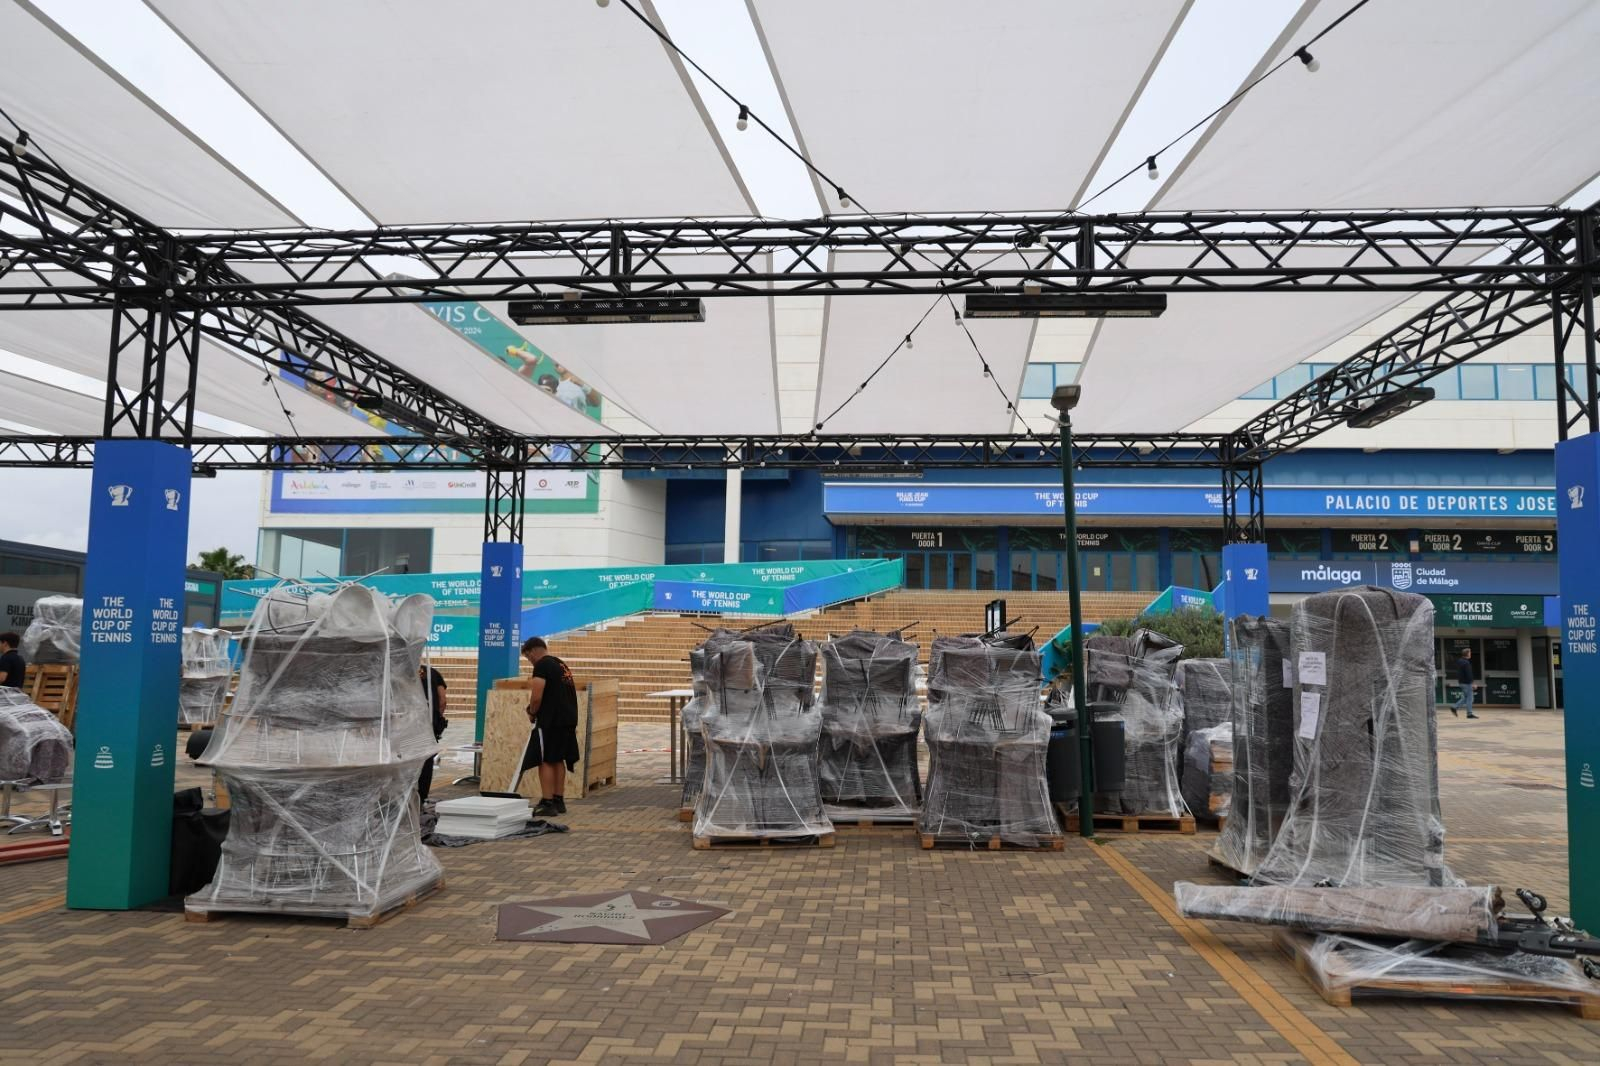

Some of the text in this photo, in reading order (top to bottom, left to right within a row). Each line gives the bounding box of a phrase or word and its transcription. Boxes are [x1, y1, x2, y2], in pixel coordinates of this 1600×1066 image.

[429, 306, 466, 322] VIS
[1035, 492, 1099, 500] THE WOD CUP
[1046, 500, 1087, 508] OF TNIS
[1326, 495, 1556, 511] PALACIO DE DEPORTES JOSE
[911, 532, 936, 540] PUERTA
[937, 532, 943, 547] 1
[1351, 534, 1376, 542] PUERTA
[1424, 534, 1450, 543] PUERTA
[1515, 535, 1542, 543] PUERTA
[918, 540, 935, 548] DOOR
[1359, 542, 1376, 550] DOOR
[1378, 533, 1389, 550] 2
[1432, 542, 1450, 551] DOOR
[1452, 534, 1462, 550] 2
[1544, 535, 1554, 551] 3
[1523, 543, 1542, 552] DOOR
[791, 566, 804, 574] CUP
[1416, 567, 1446, 576] Ciudad
[614, 574, 640, 582] WORLD
[640, 573, 655, 581] CUP
[1416, 577, 1459, 586] de Málaga
[448, 580, 475, 588] WORLD
[609, 582, 618, 590] OF
[442, 587, 481, 596] OF TENNIS
[692, 590, 751, 600] THE WORLD CUP
[103, 596, 125, 607] THE
[160, 598, 174, 609] THE
[702, 599, 740, 608] OF TENNIS
[7, 605, 34, 616] BILLIE
[1453, 602, 1493, 613] TICKETS
[1573, 604, 1589, 615] THE
[93, 608, 133, 619] WORLD
[152, 609, 178, 620] WORLD
[92, 620, 133, 631] CUP OF
[152, 621, 178, 631] CUP OF
[1568, 616, 1596, 628] WORLD
[434, 624, 453, 632] CUP
[91, 632, 132, 643] TENNIS
[151, 633, 177, 643] TENNIS
[1568, 629, 1596, 641] CUP OF
[1568, 642, 1597, 653] TENNIS
